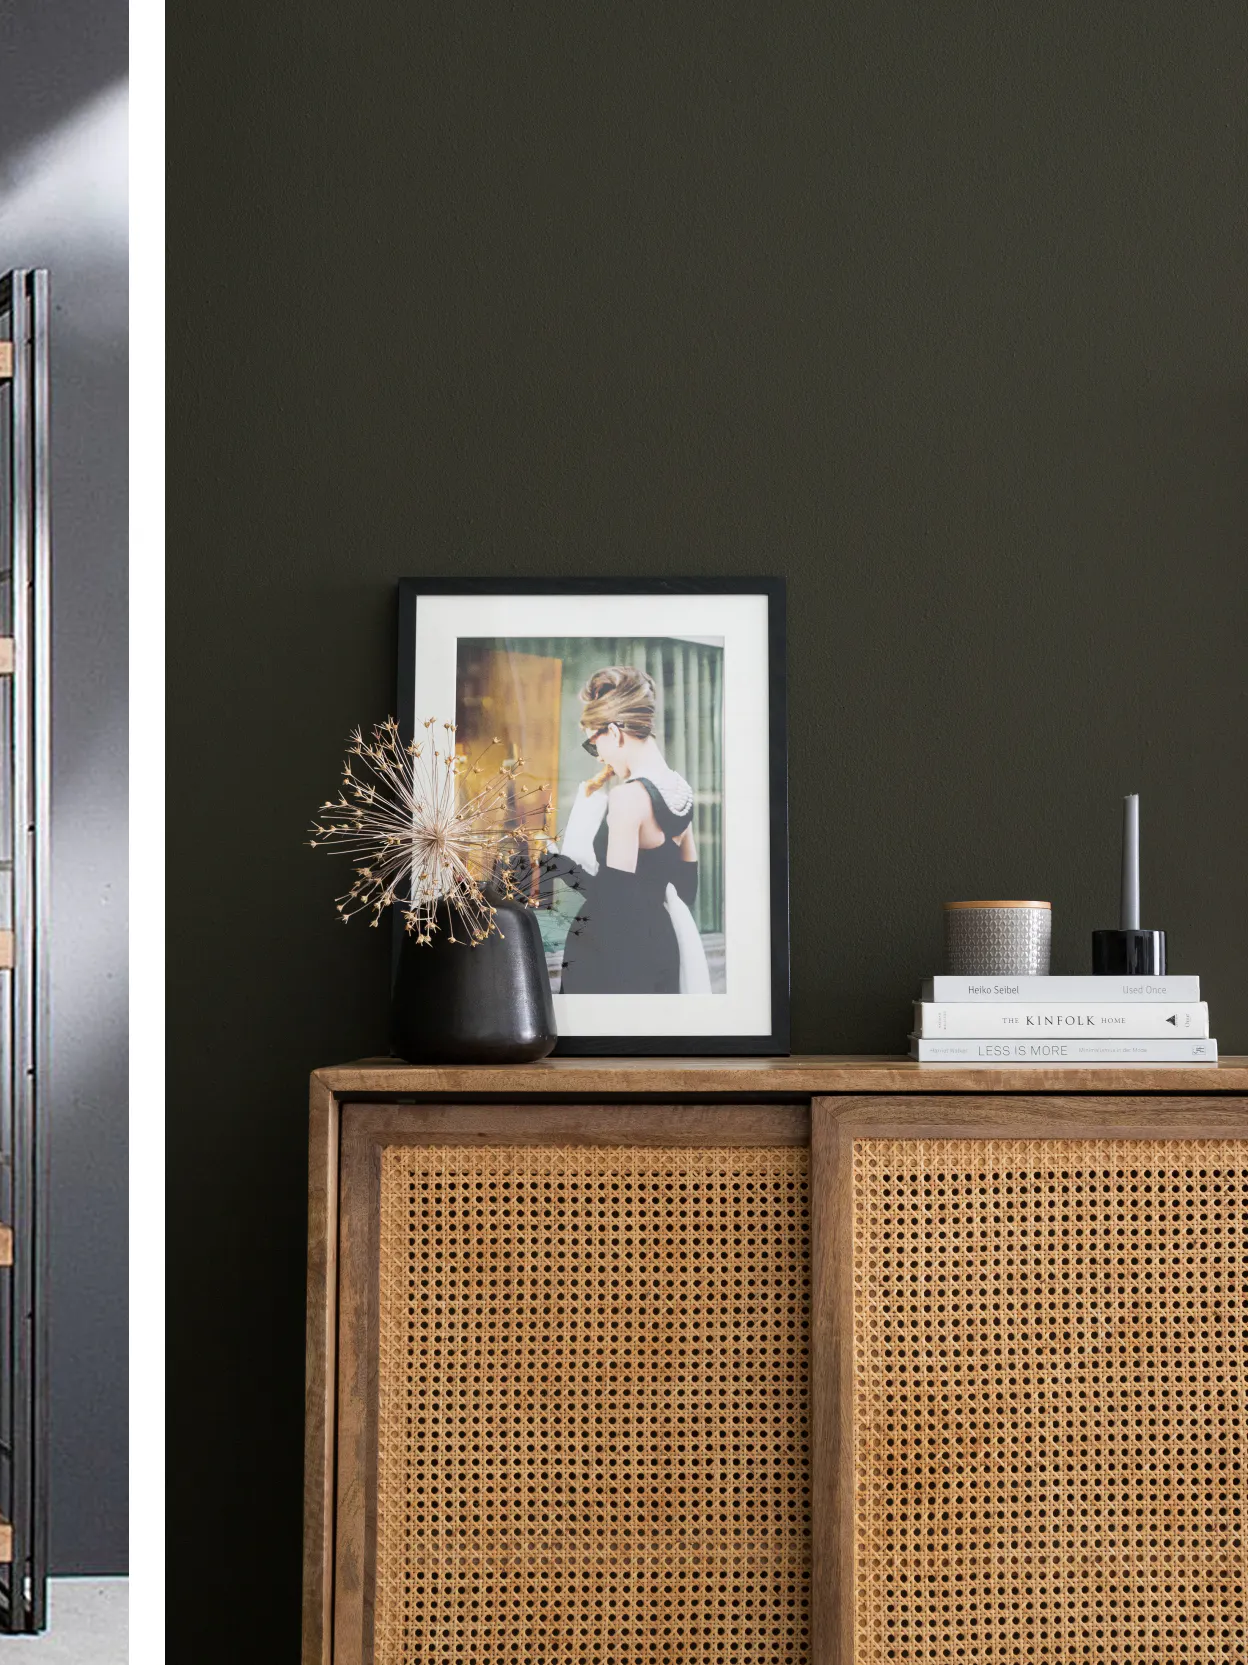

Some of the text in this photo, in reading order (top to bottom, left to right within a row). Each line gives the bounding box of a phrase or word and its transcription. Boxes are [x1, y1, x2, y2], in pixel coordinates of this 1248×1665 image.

[968, 985, 1019, 995] Heiko Seibel
[1122, 985, 1167, 995] Used Once
[1025, 1015, 1096, 1026] KINFOLK
[978, 1045, 1011, 1057] LESS
[1014, 1045, 1027, 1057] IS
[1030, 1045, 1068, 1057] MORE
